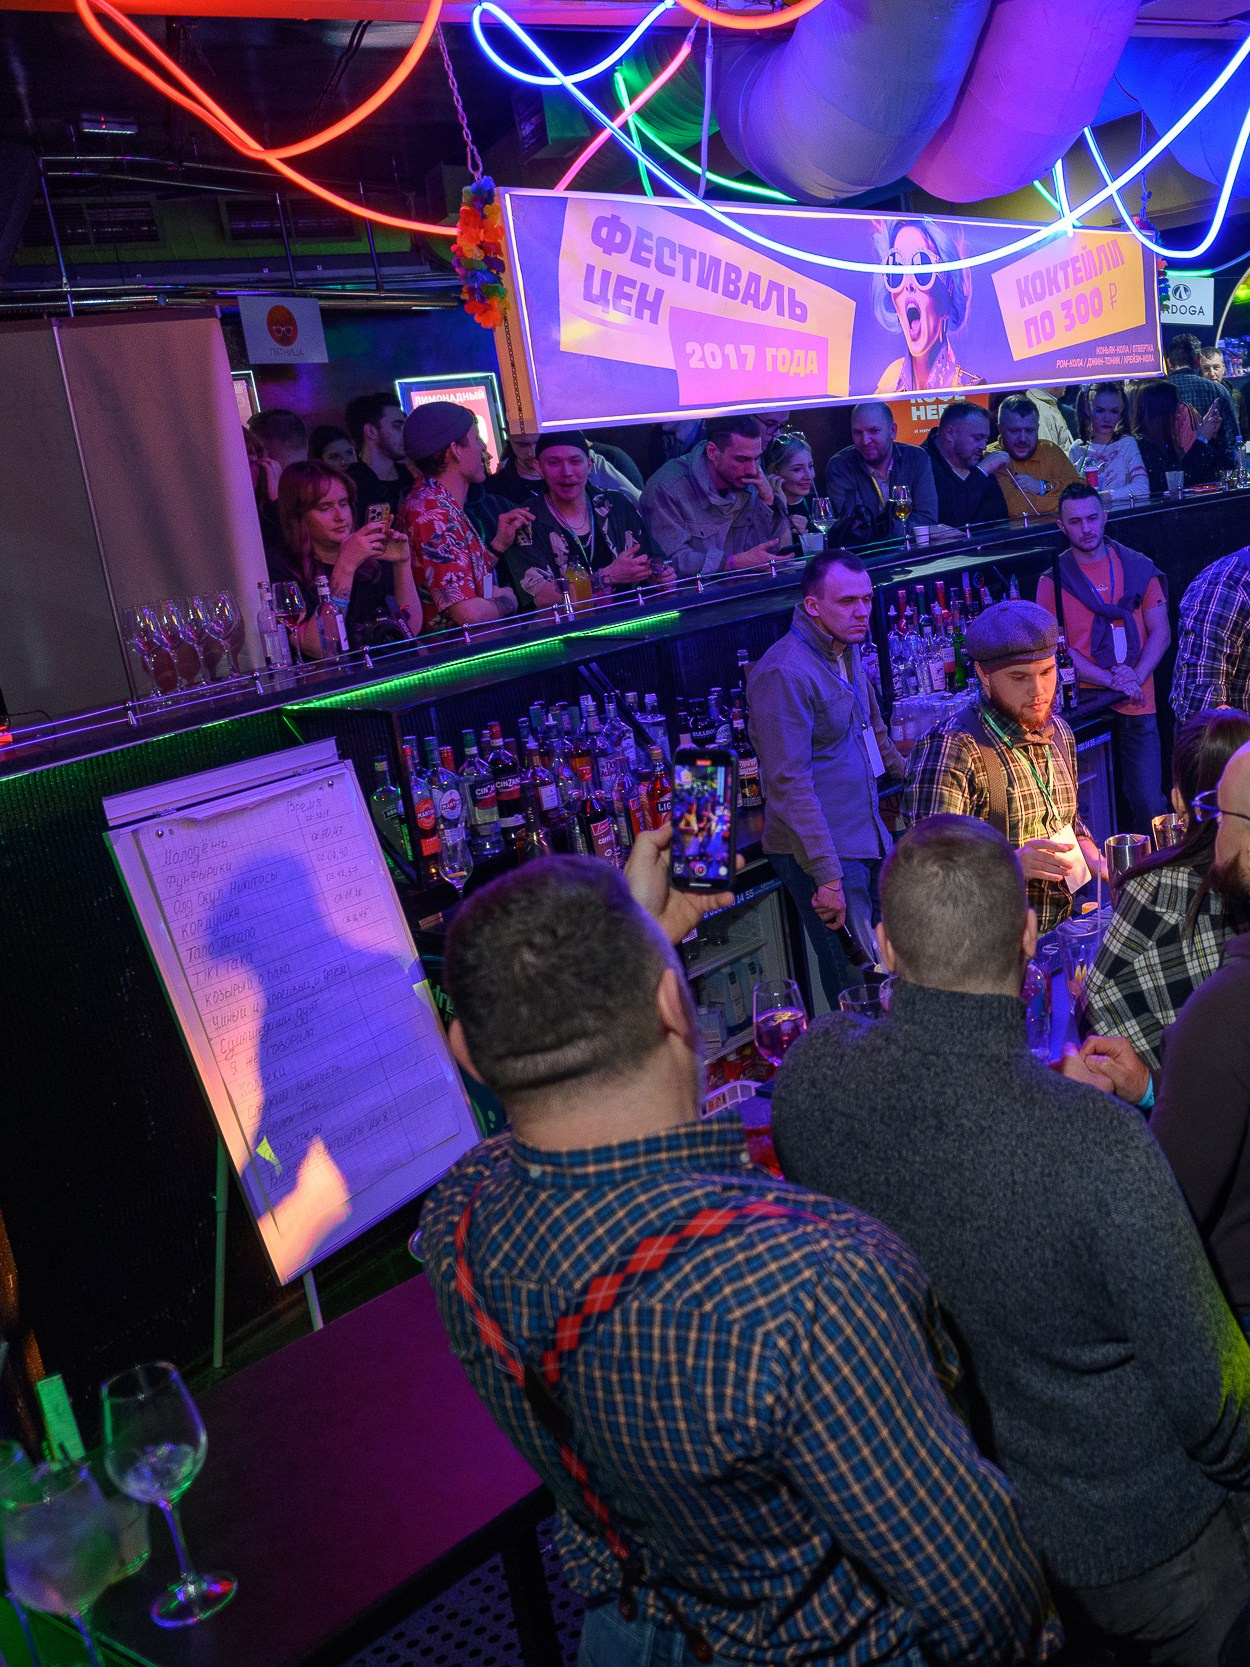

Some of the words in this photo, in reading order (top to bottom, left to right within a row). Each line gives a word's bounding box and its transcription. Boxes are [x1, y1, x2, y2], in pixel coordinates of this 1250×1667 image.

[583, 263, 665, 325] ЦЕН
[591, 214, 808, 323] ФЕСТИВАЛЬ
[1016, 239, 1125, 309] КОКТЕЙЛИ
[1024, 310, 1056, 349] ПО
[1060, 287, 1104, 332] 300
[685, 341, 756, 371] 2017
[765, 347, 819, 377] ГОДА
[415, 389, 485, 406] ЛИМОНАДНЫЙ
[745, 888, 754, 900] 55
